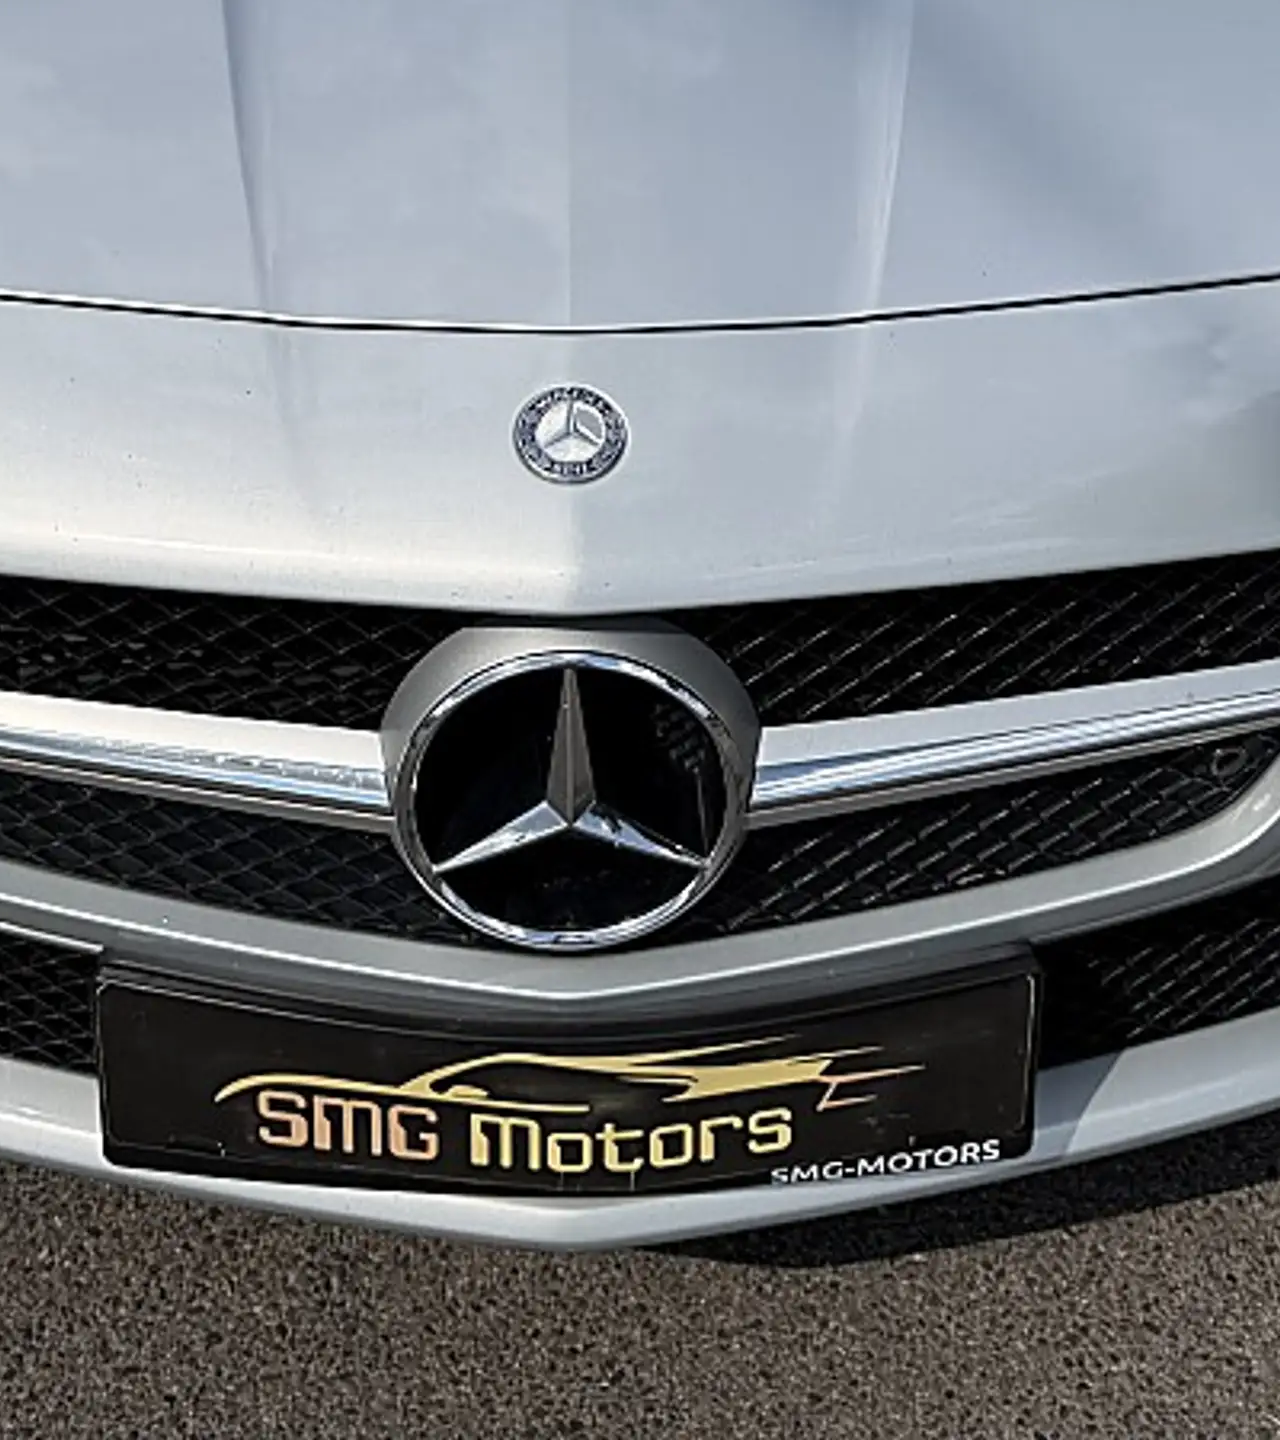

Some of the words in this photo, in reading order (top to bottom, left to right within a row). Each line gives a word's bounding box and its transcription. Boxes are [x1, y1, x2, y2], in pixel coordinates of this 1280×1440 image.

[257, 1089, 438, 1161] SMG
[469, 1107, 793, 1174] Motors
[770, 1139, 1001, 1184] SMG-MOTORS
